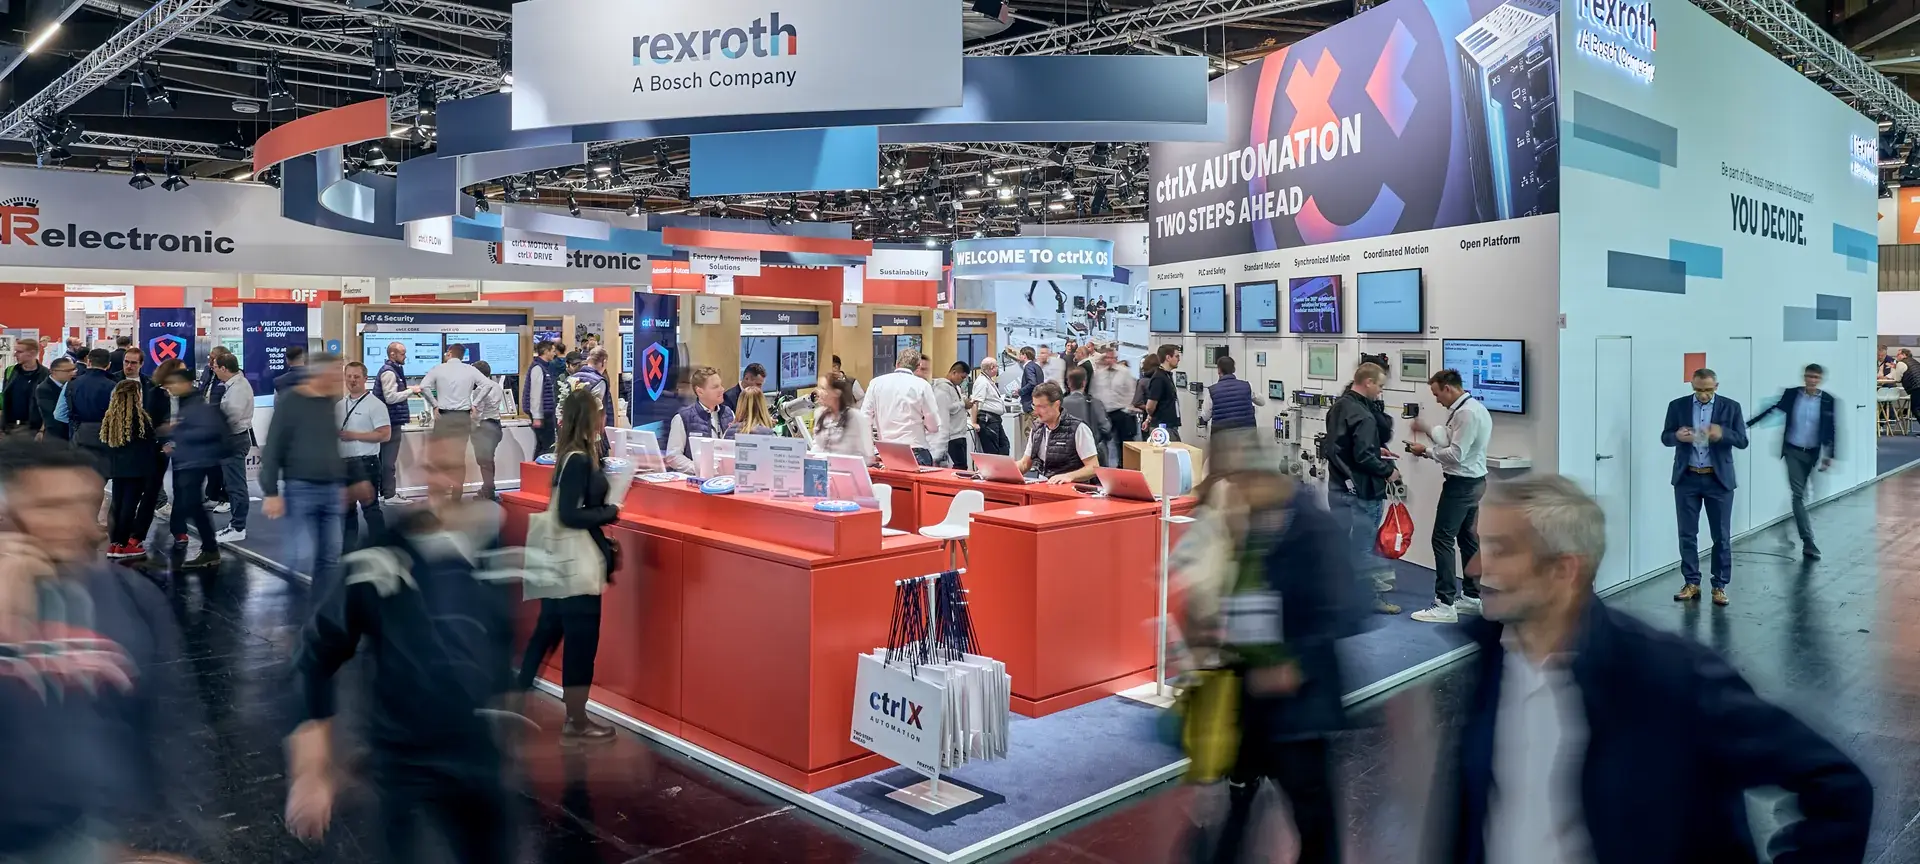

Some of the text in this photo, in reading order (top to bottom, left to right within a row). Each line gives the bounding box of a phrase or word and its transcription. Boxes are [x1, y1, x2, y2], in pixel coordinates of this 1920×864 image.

[632, 12, 797, 66] rexroth
[632, 70, 797, 93] A Bosch Company
[1156, 113, 1361, 203] ctrlX AUTOMATION
[1721, 161, 1728, 176] Be
[1729, 167, 1739, 181] part
[1740, 167, 1746, 181] of
[1754, 175, 1764, 187] most
[1765, 179, 1774, 192] open
[1156, 186, 1303, 239] TWO STEPS AHEAD
[1730, 192, 1806, 246] YOU DECIDE.
[41, 224, 235, 254] electronic
[512, 240, 527, 248] ctrlX
[527, 241, 553, 250] MOTION
[1460, 235, 1520, 251] Open Platform
[693, 253, 758, 262] Factory Automation
[956, 249, 1108, 266] WELCOME TO ctrlX OS
[1363, 244, 1429, 259] Coordinated Motion
[709, 263, 741, 271] Solutions
[1244, 260, 1281, 271] Standard Motion
[1294, 253, 1351, 267] Synchronized Motion
[879, 268, 929, 277] Sustainability
[1213, 266, 1226, 275] Safety
[292, 289, 317, 303] OFF
[384, 315, 414, 323] Security
[655, 319, 670, 327] World
[778, 314, 790, 323] Safety
[869, 691, 923, 730] ctrlX
[869, 716, 921, 743] AUTOMATION
[916, 760, 936, 773] rexroth
